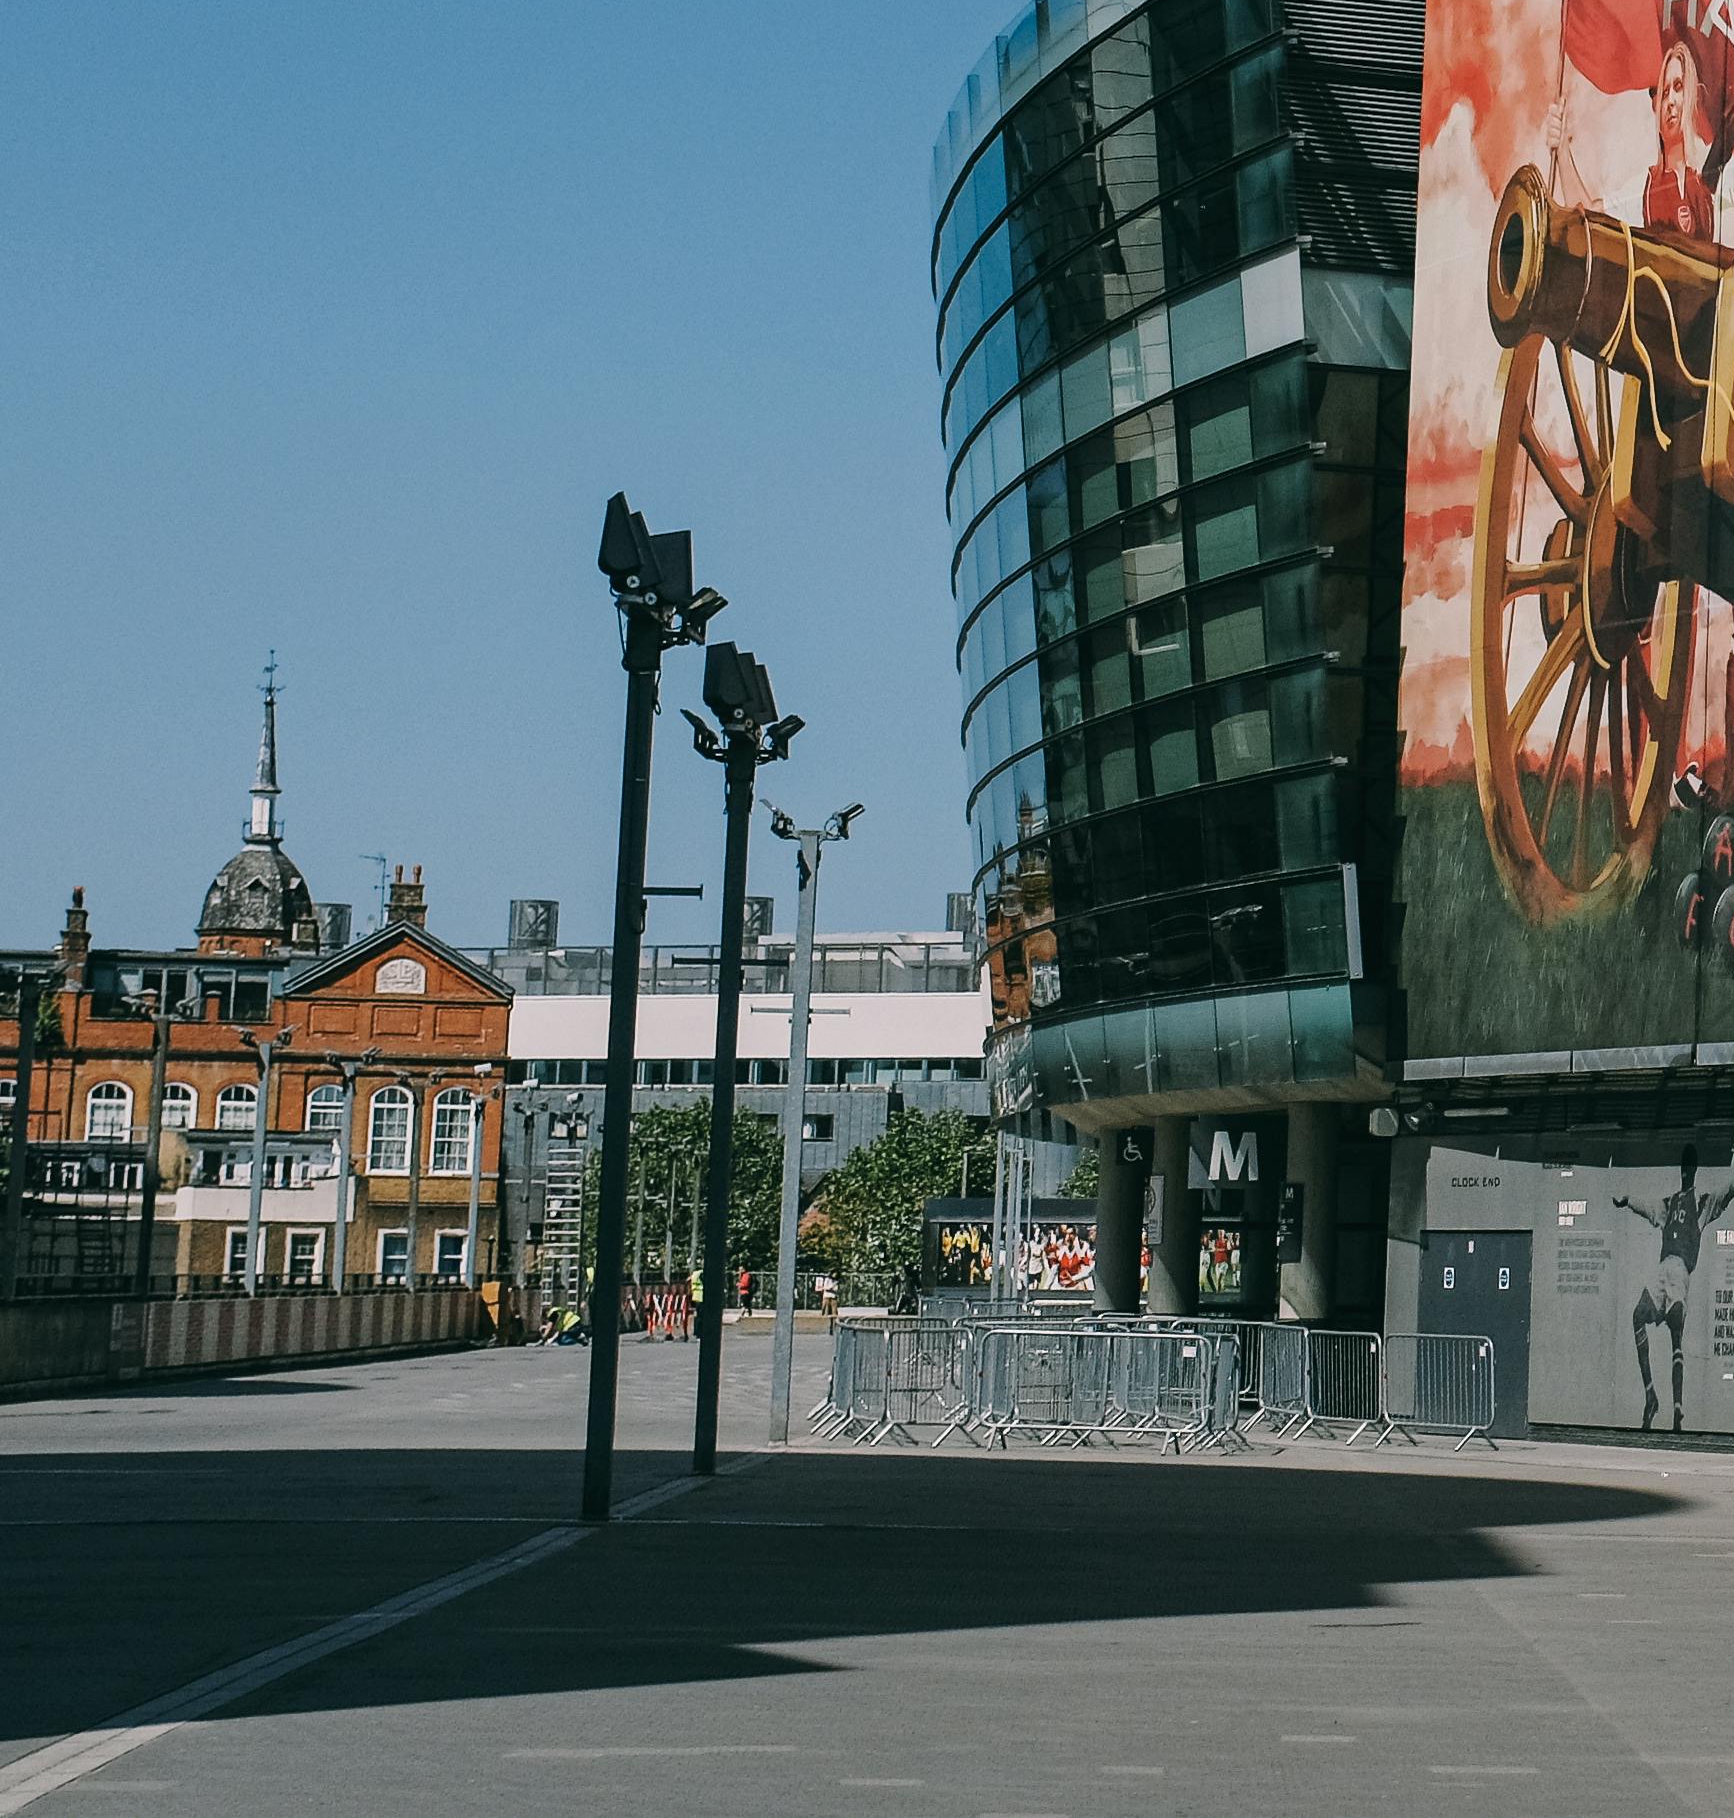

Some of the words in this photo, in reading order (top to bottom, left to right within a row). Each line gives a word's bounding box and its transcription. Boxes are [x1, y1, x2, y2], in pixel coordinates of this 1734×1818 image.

[1714, 822, 1734, 877] A
[1208, 1131, 1259, 1181] M
[1451, 1177, 1479, 1187] CLOCK
[1482, 1177, 1500, 1187] END
